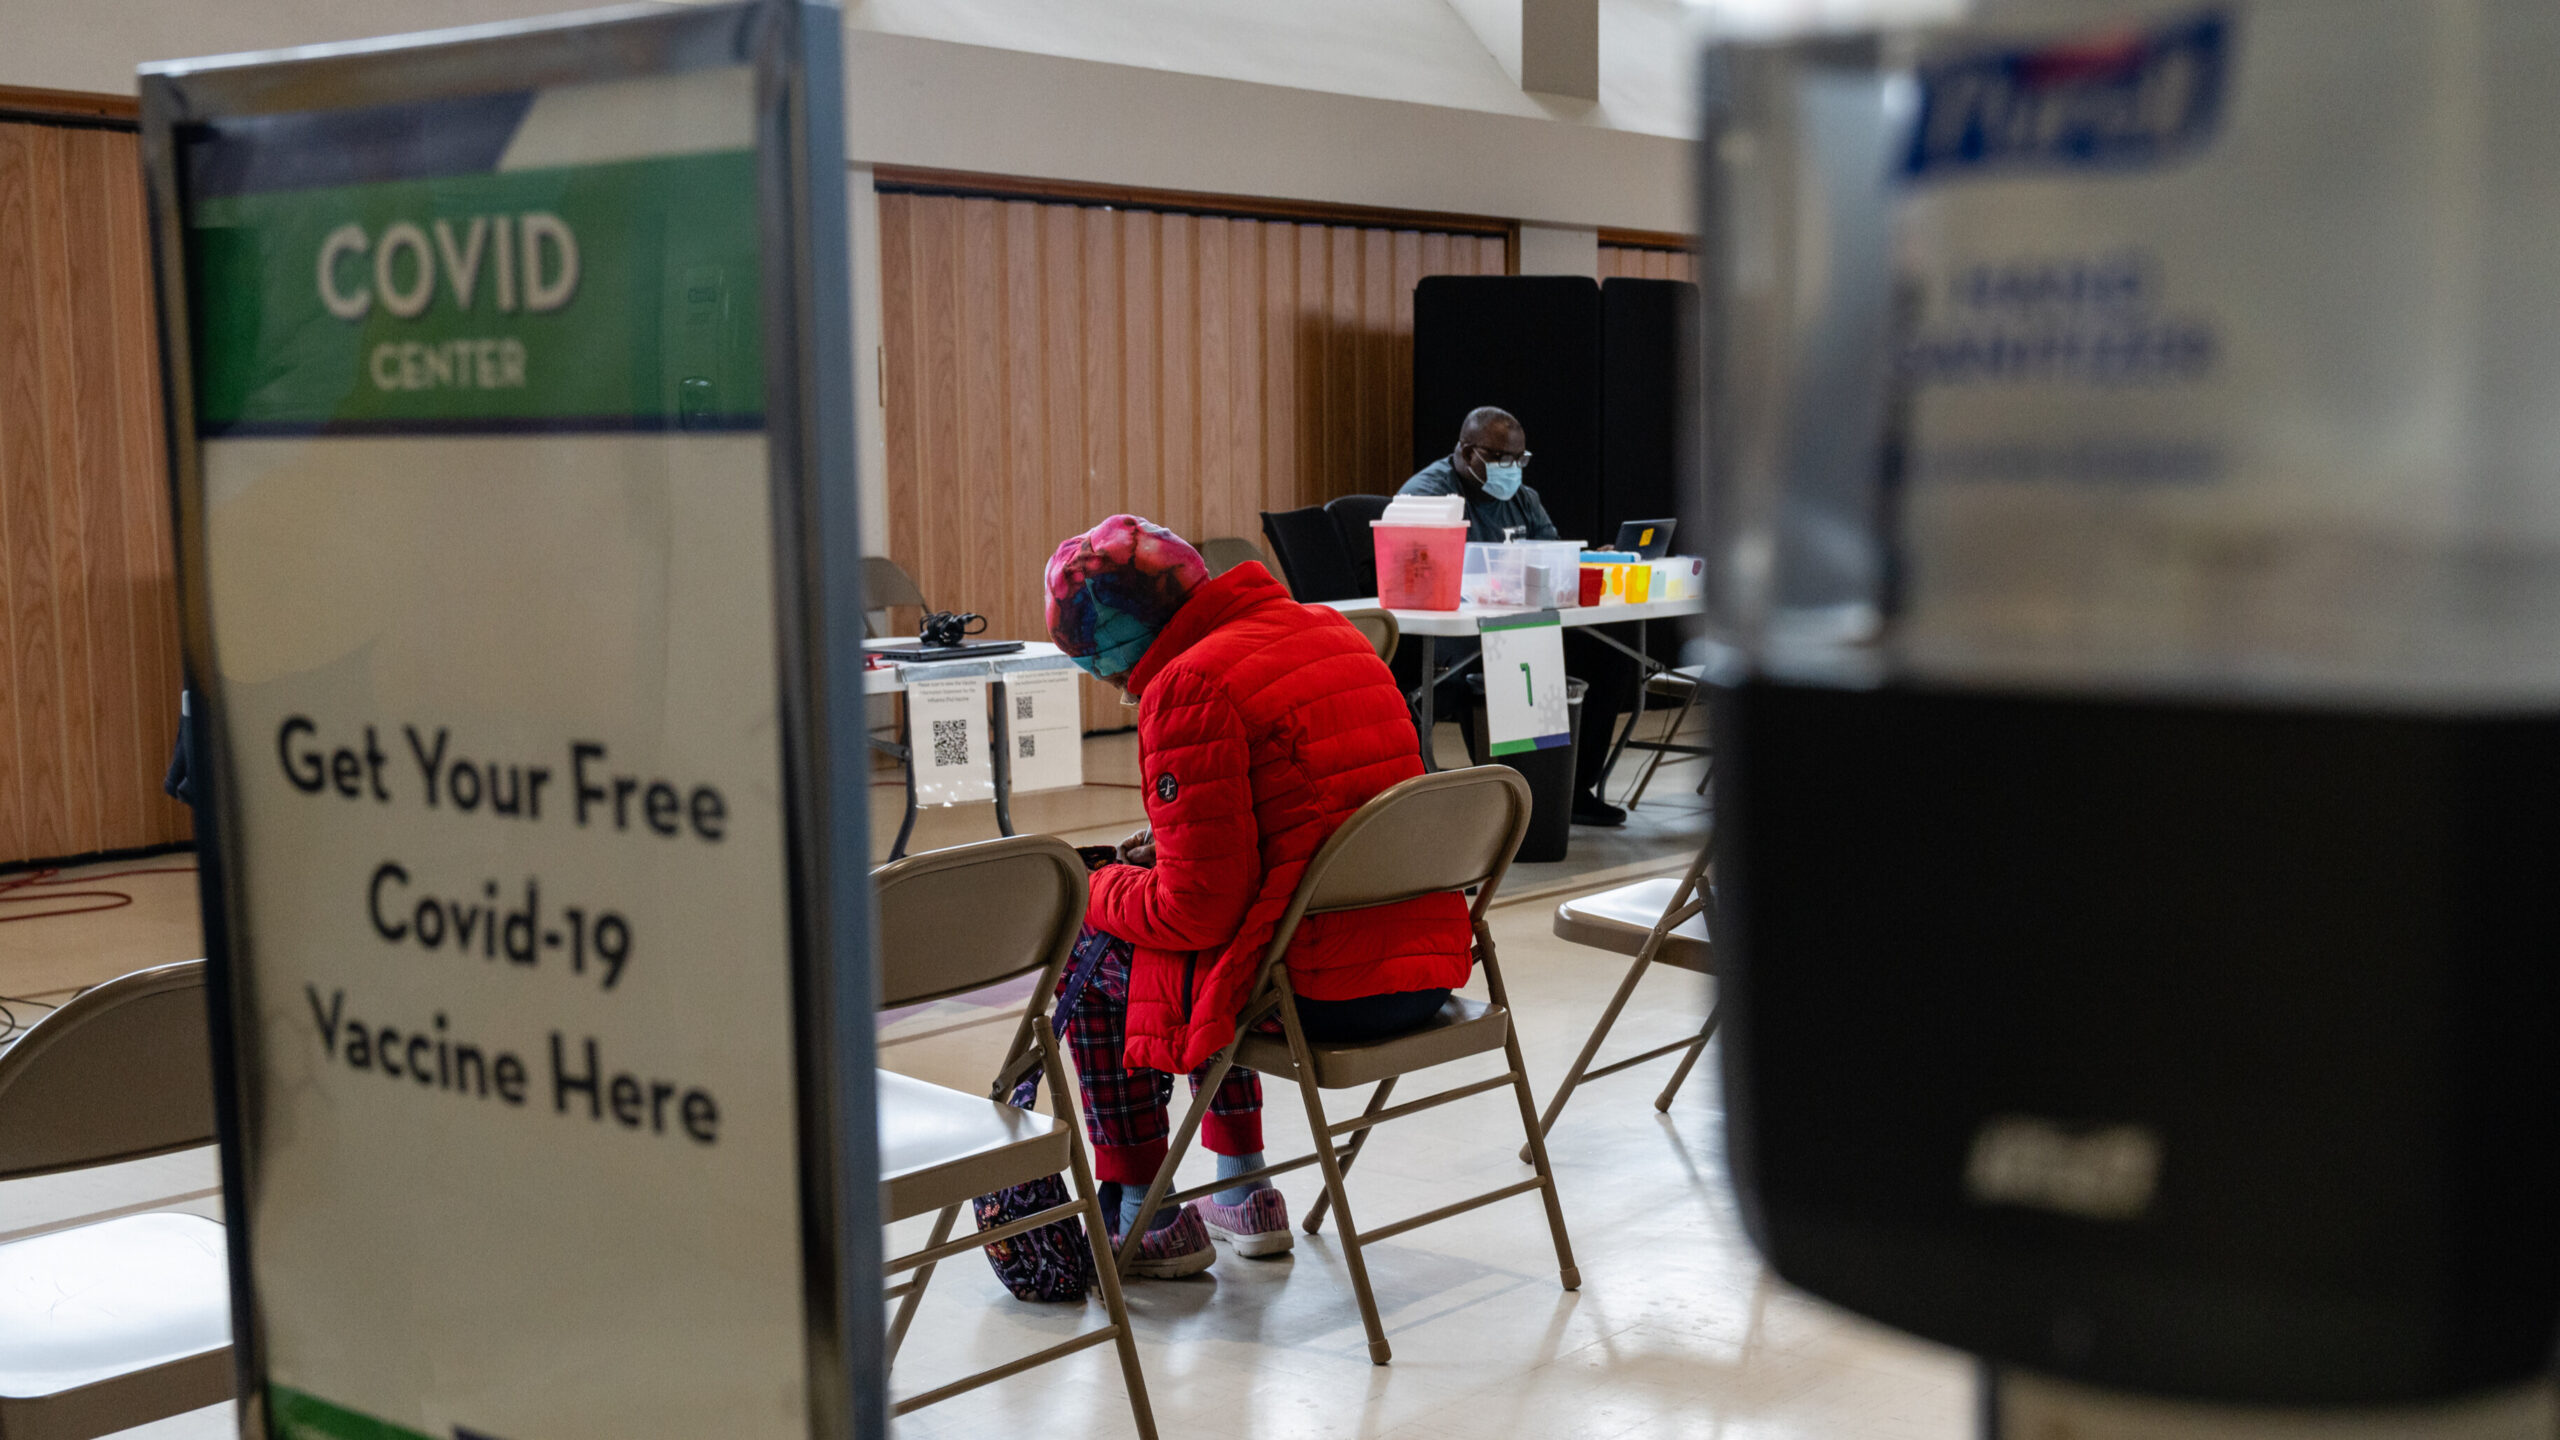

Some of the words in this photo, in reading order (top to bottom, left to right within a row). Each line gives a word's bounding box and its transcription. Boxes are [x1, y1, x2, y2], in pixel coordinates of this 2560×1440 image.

[317, 212, 580, 319] COVID
[369, 338, 527, 391] CENTER
[1520, 663, 1533, 707] 1
[277, 715, 390, 802] Get
[404, 723, 551, 819] Your
[570, 740, 728, 842] Free
[368, 860, 633, 991] Covid-19
[305, 983, 528, 1106] Vaccine
[549, 1029, 720, 1144] Here
